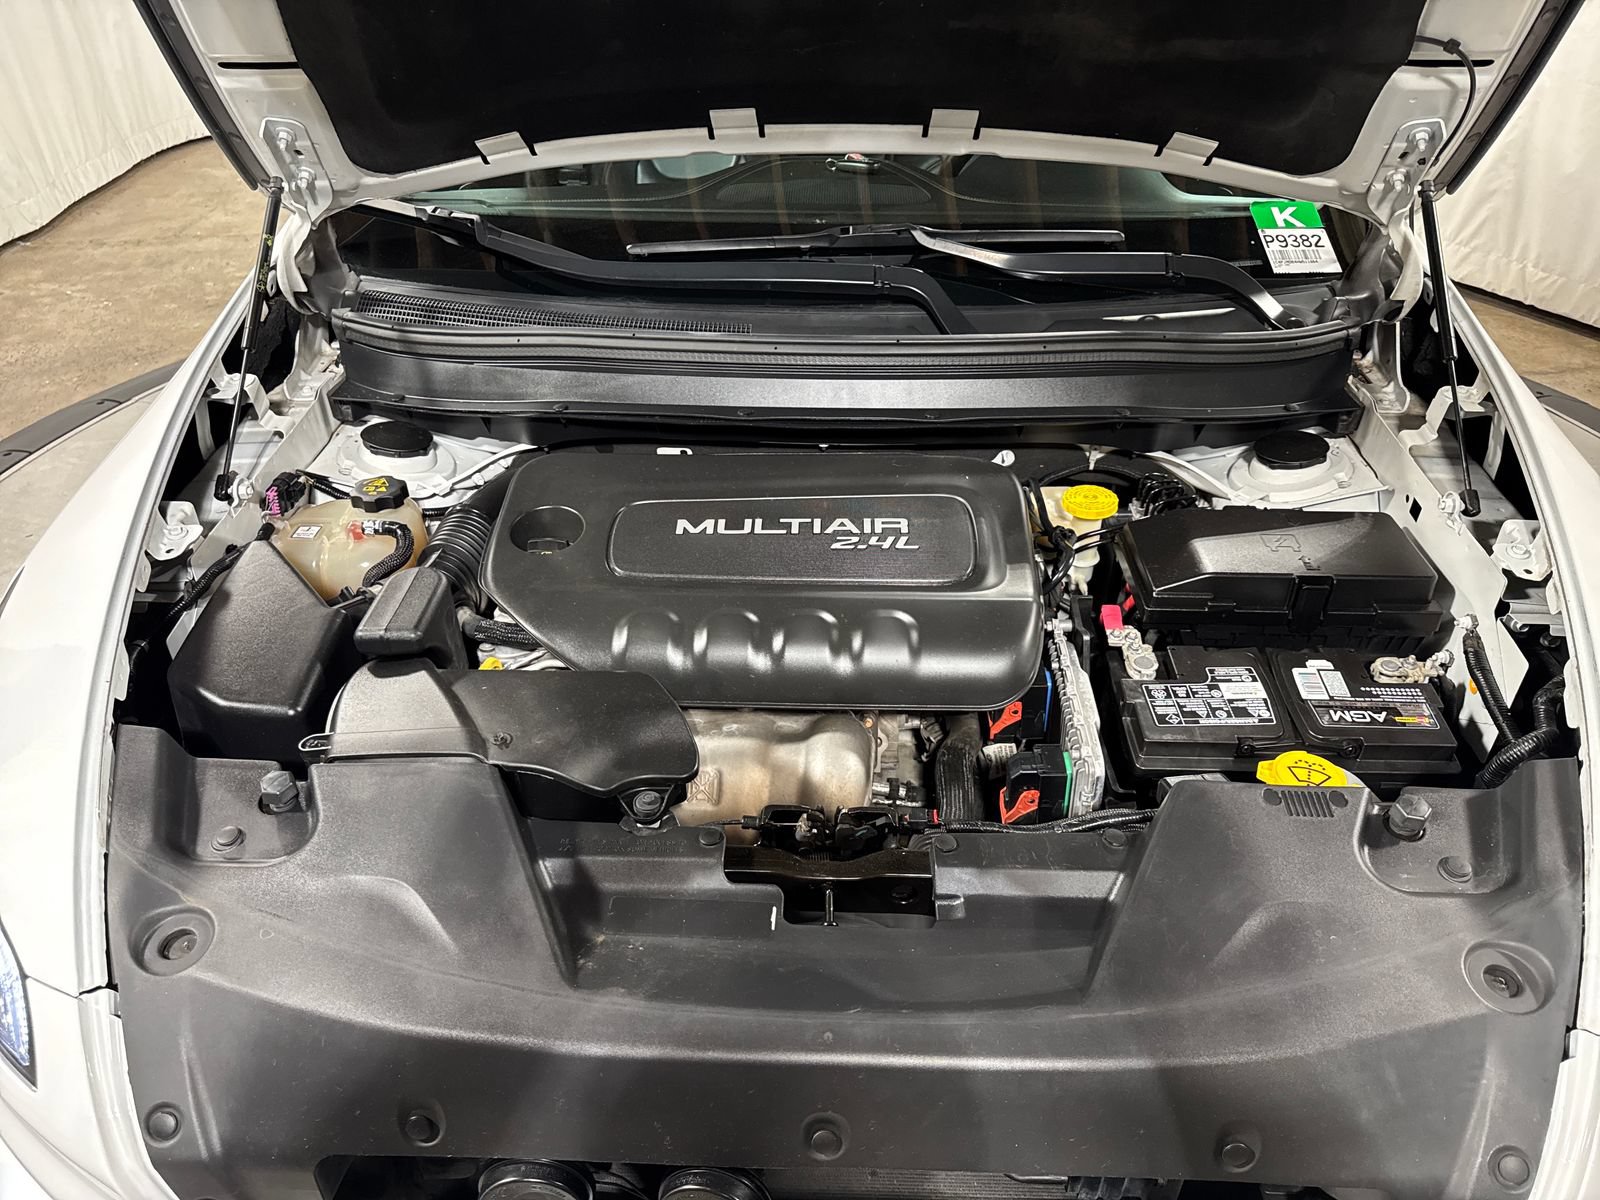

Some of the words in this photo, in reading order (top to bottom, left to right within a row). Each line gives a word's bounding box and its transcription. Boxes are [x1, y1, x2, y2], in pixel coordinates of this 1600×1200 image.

[1270, 206, 1307, 228] K
[1262, 234, 1326, 249] P9382
[675, 518, 909, 535] MULTIAIR
[830, 536, 920, 550] 2.4L
[1329, 710, 1388, 723] AGM
